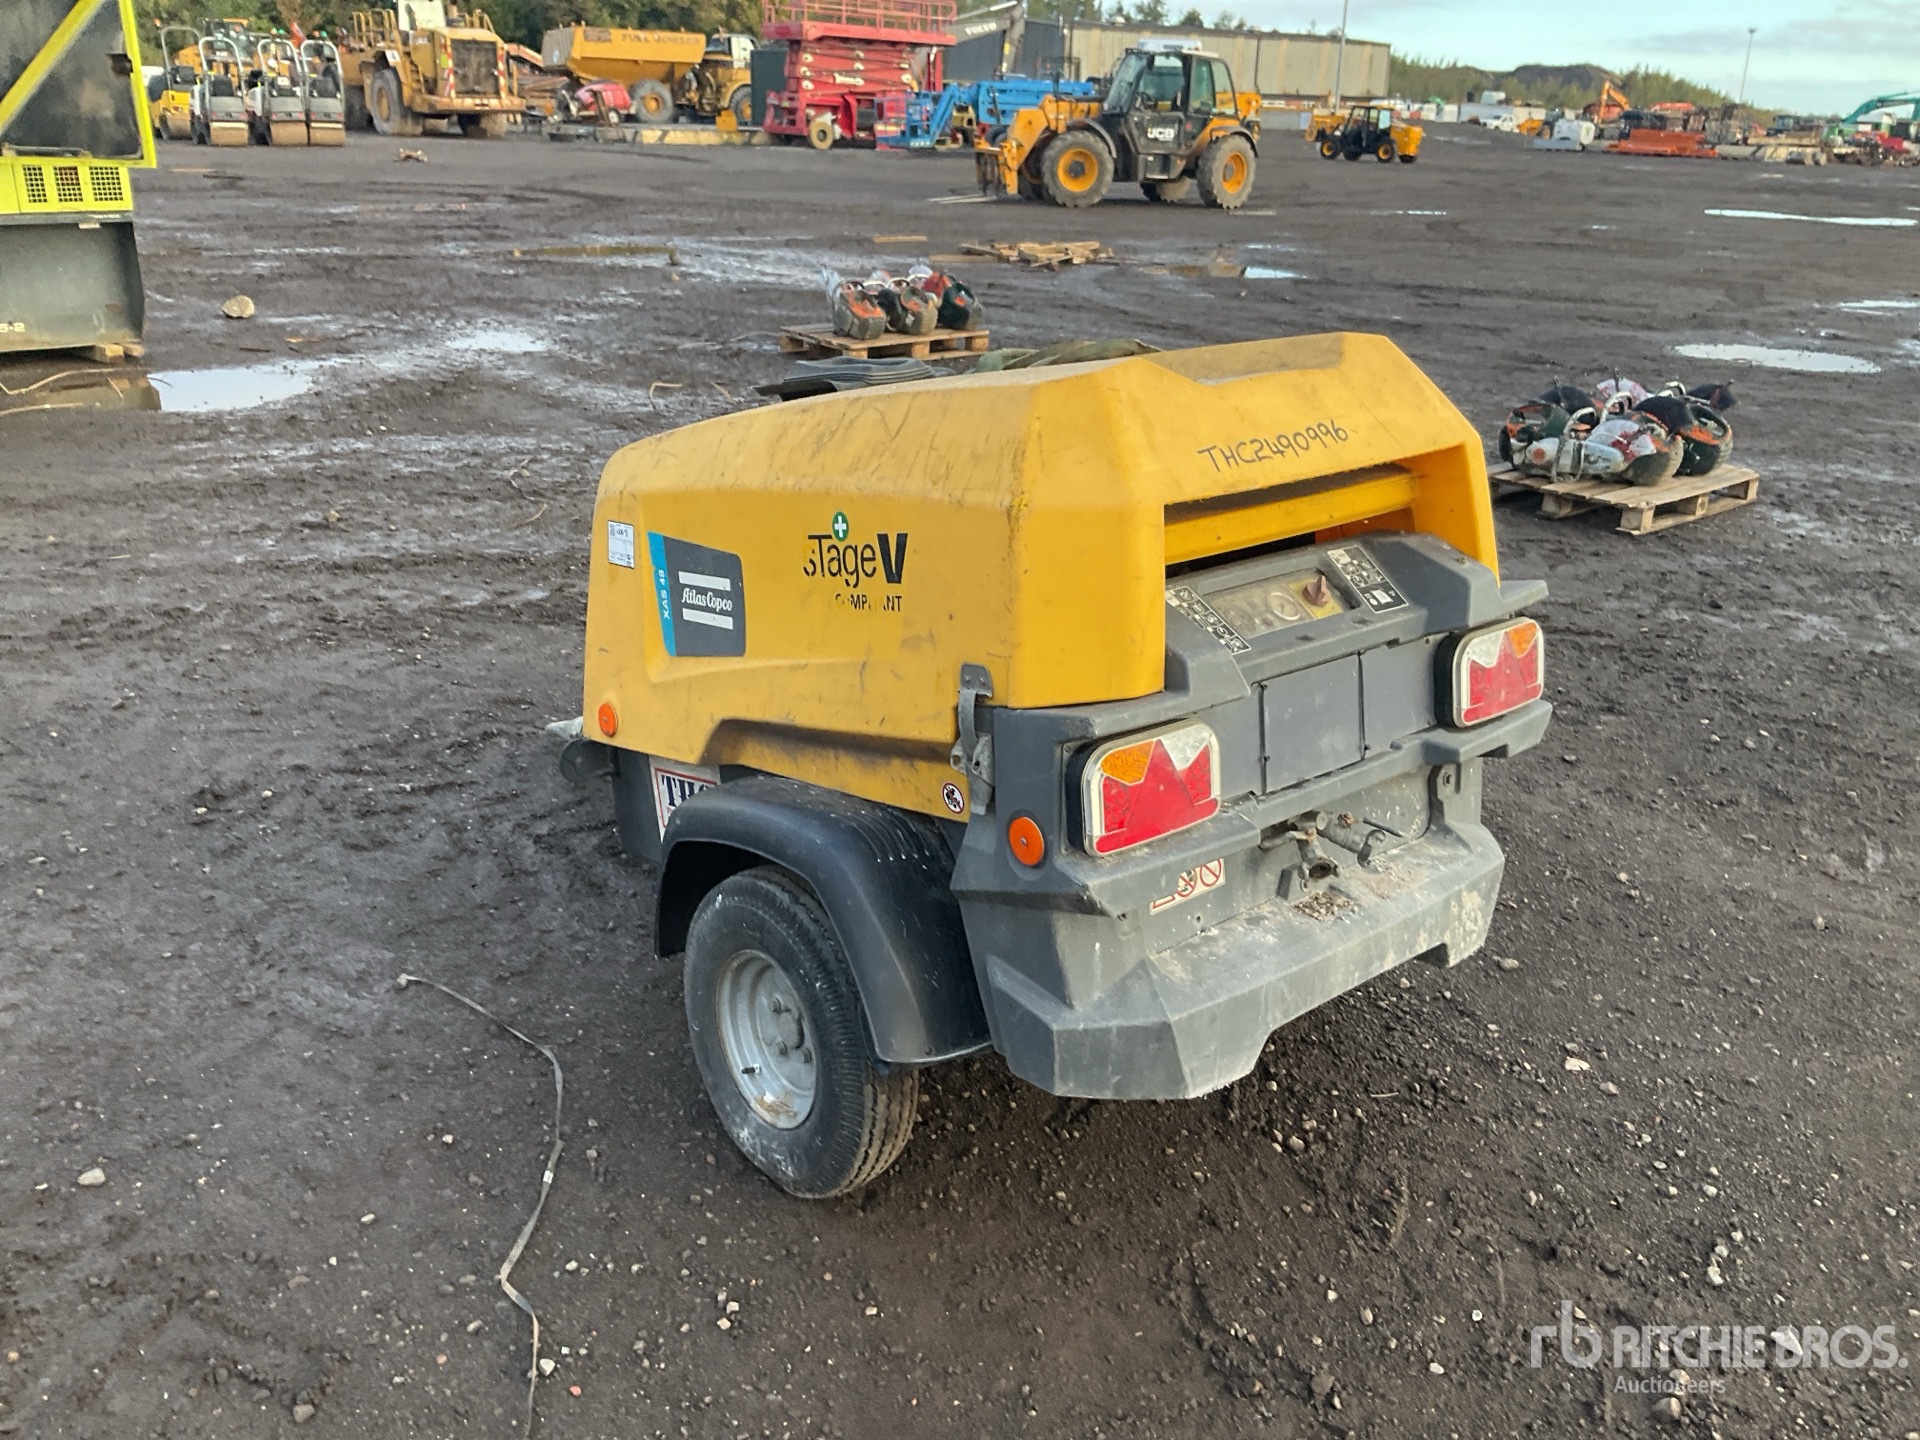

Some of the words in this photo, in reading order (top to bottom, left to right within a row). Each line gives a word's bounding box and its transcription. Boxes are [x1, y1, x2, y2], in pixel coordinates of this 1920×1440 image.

[1147, 127, 1175, 140] JCB
[1197, 418, 1349, 473] THC2490996
[876, 532, 909, 585] V
[660, 589, 670, 620] XAS
[661, 774, 710, 808] TH
